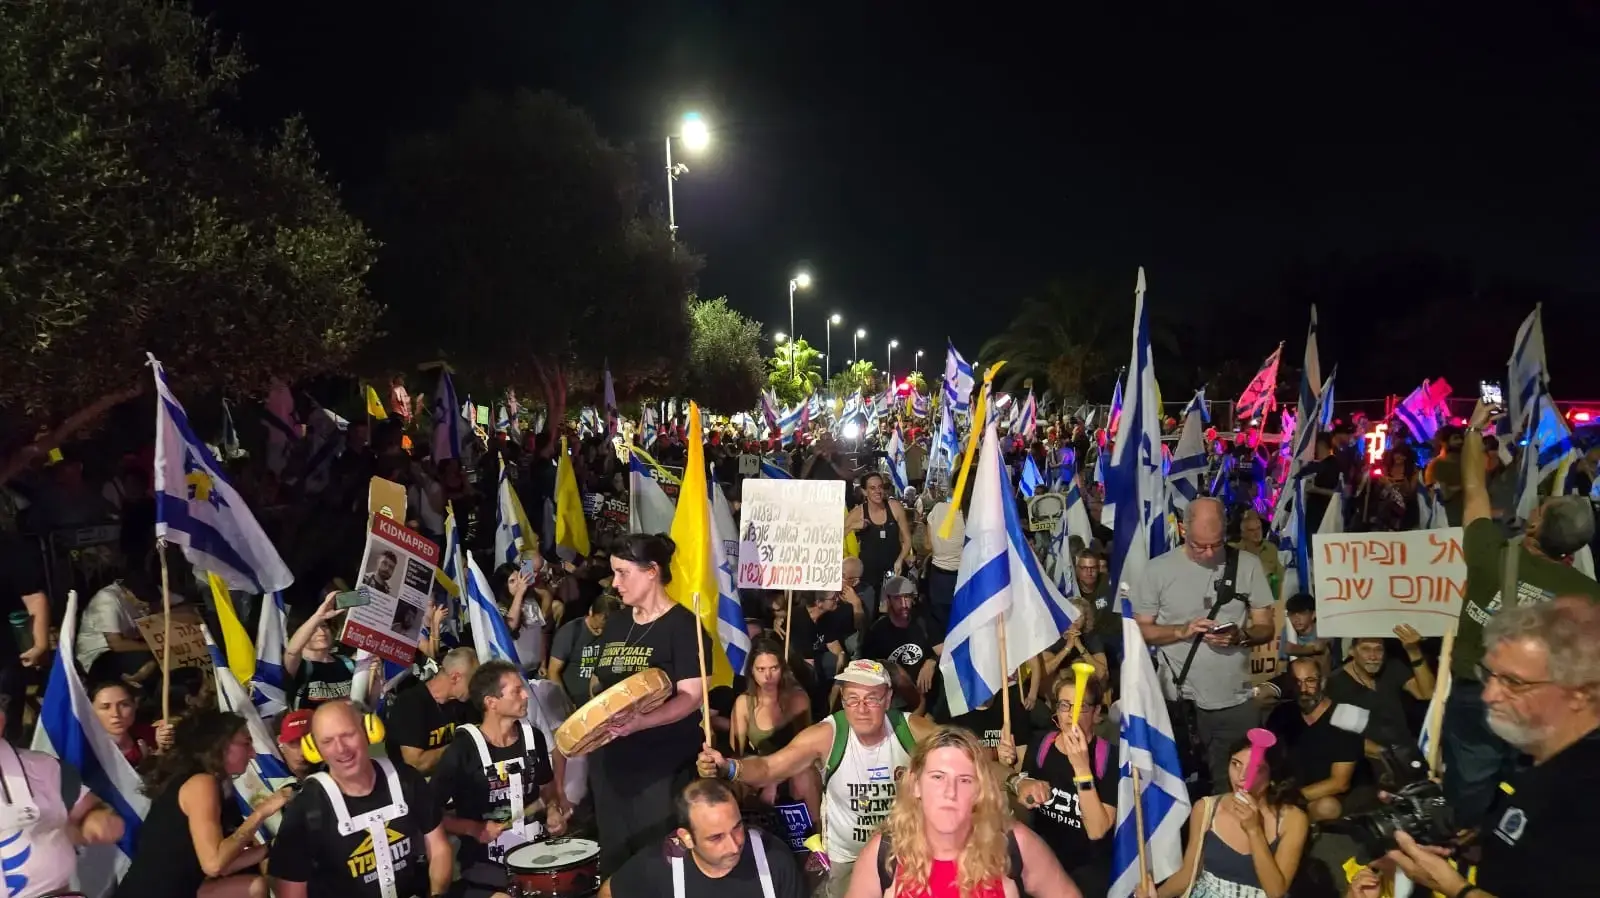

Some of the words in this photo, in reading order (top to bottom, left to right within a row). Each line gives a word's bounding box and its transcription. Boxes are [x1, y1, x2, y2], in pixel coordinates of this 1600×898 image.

[380, 519, 434, 557] KIDNAPPED
[1324, 540, 1407, 573] תפקירו
[740, 563, 767, 586] עכשיו
[767, 566, 802, 587] בחירות
[1325, 577, 1374, 601] שוב
[347, 626, 366, 646] Bring
[366, 634, 379, 651] Guy
[380, 640, 395, 654] Back
[846, 783, 880, 797] כיפור
[882, 783, 897, 796] מי
[347, 851, 377, 878] פלן
